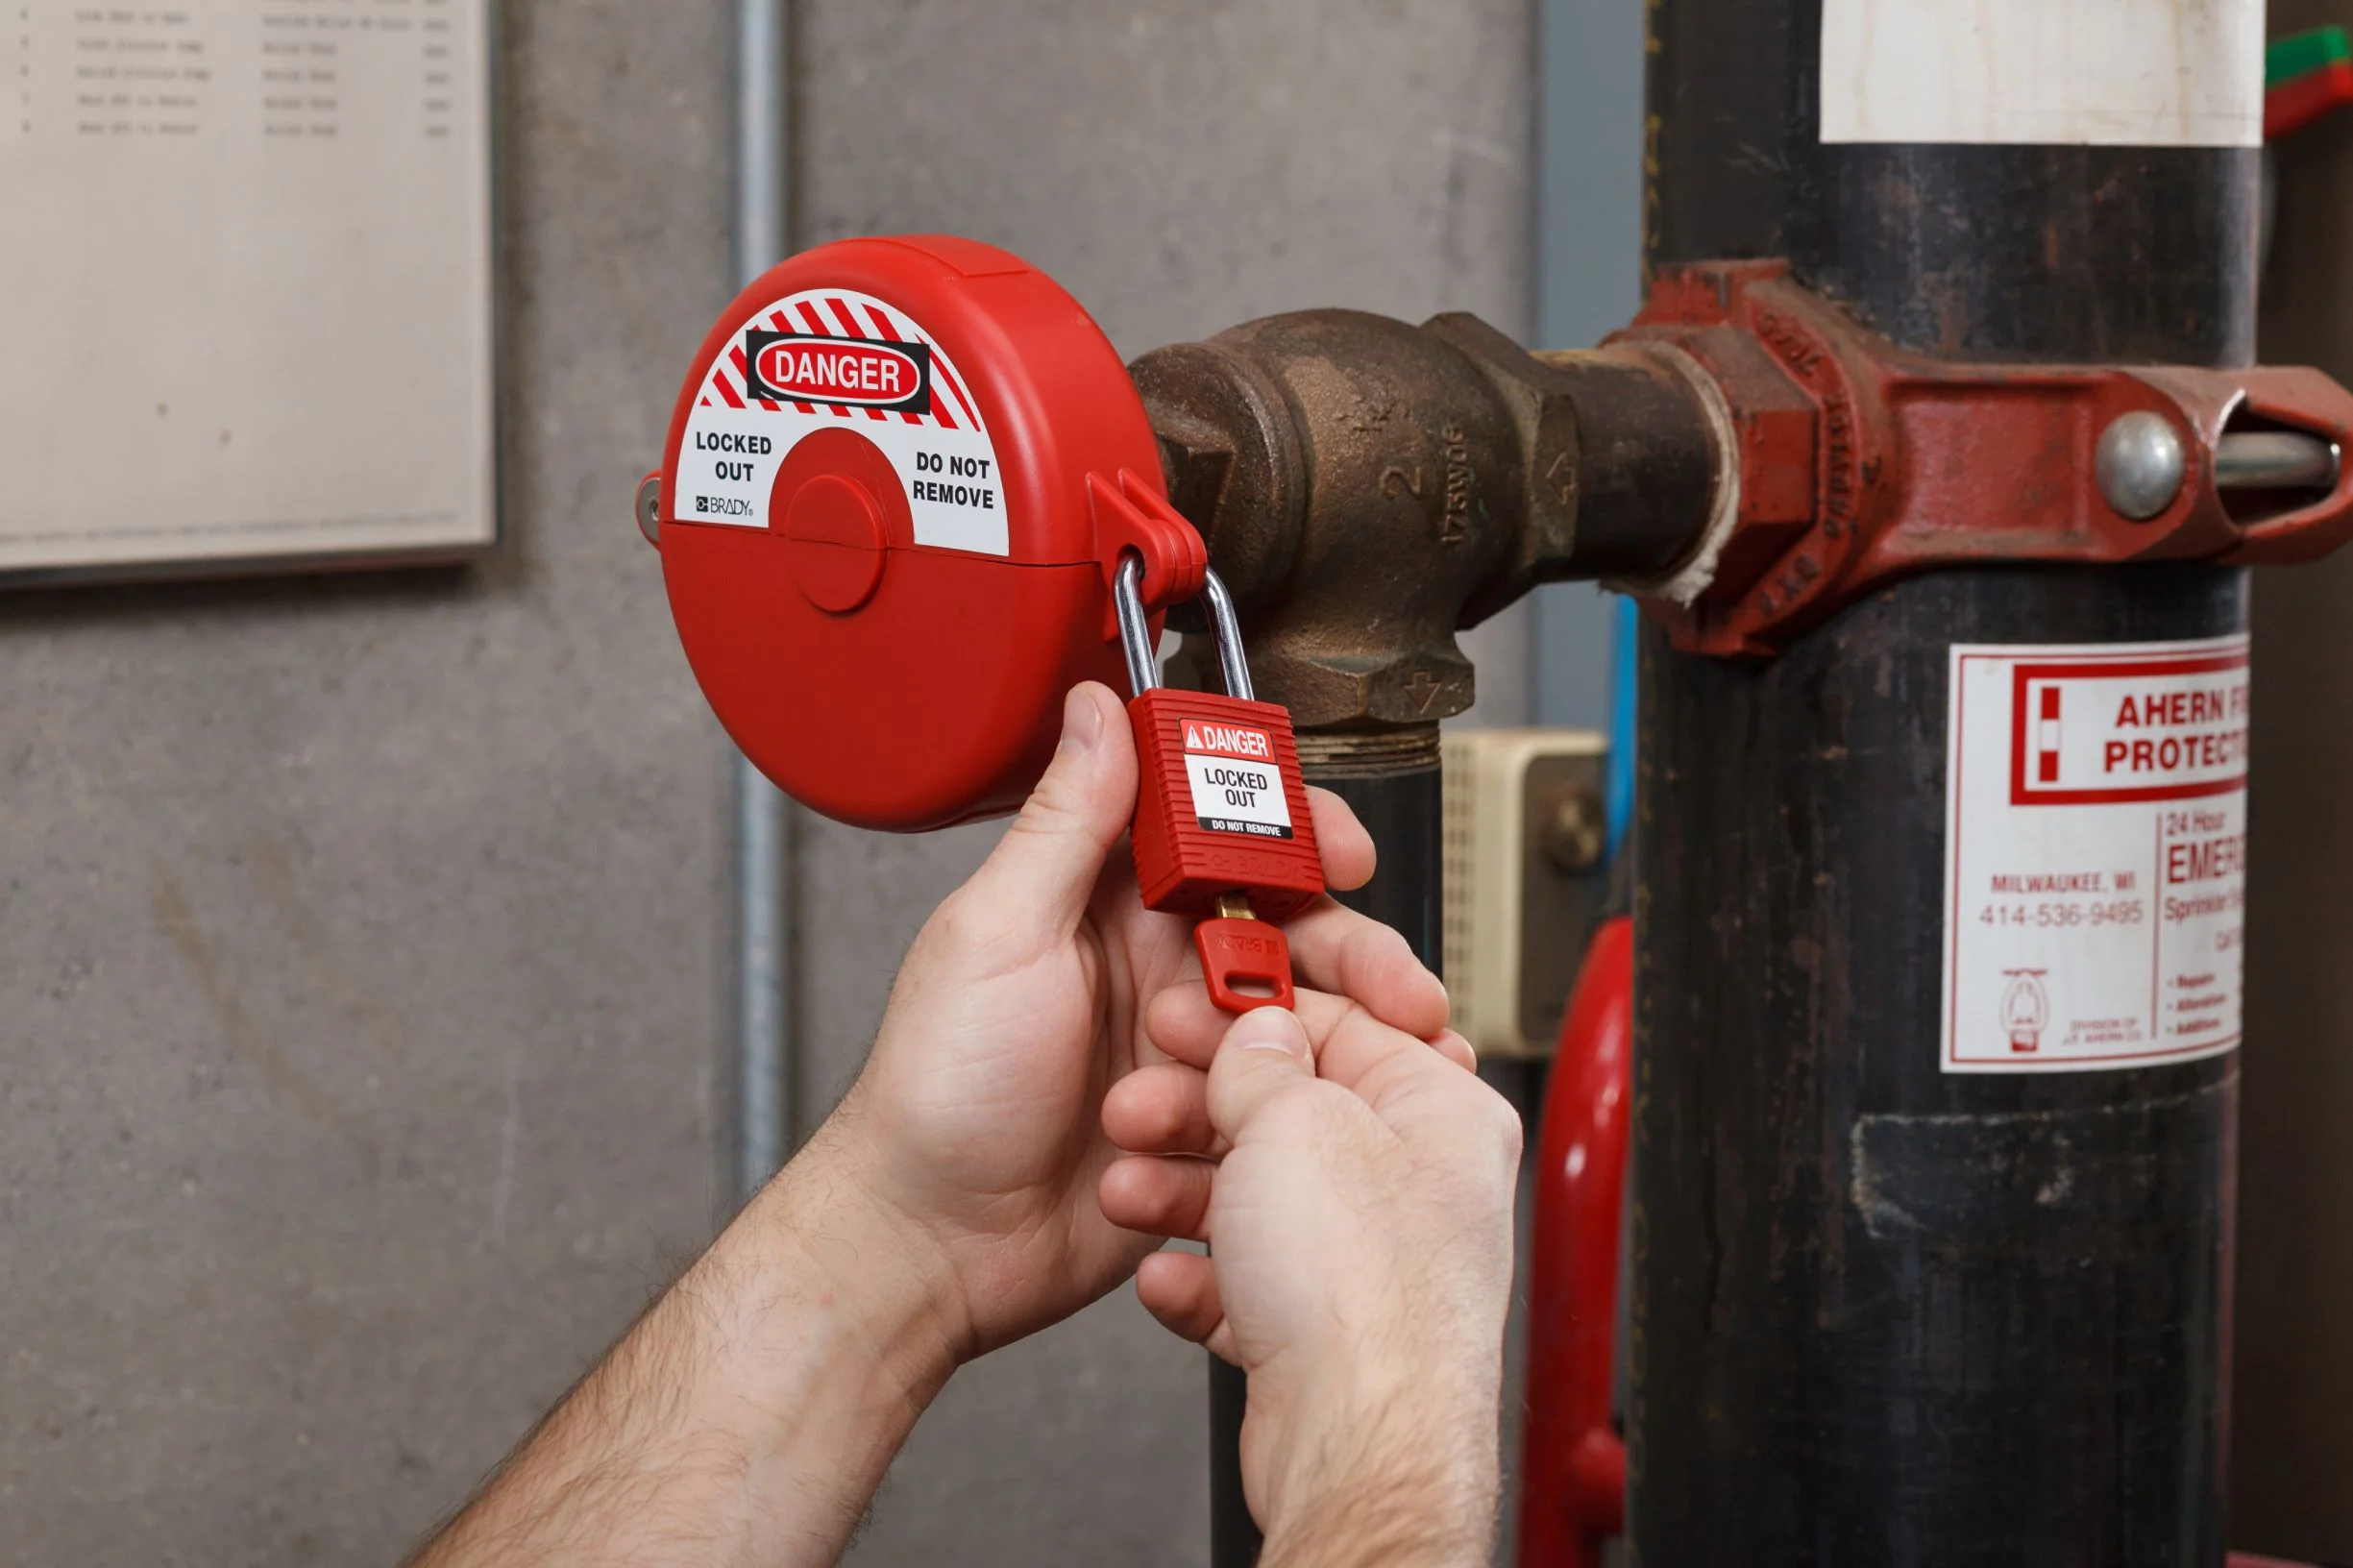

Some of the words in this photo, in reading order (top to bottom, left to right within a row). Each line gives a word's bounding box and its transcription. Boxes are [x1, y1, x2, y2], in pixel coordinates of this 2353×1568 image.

[774, 350, 900, 393] DANGER
[696, 431, 772, 455] LOCKED
[715, 461, 754, 482] OUT
[917, 452, 944, 474] DO
[950, 455, 991, 479] NOT
[913, 480, 994, 510] REMOVE
[2116, 690, 2224, 728] AHERN
[1202, 725, 1269, 758] DANGER
[1204, 768, 1268, 791] LOCKED
[1225, 789, 1256, 808] OUT
[1212, 820, 1225, 830] DO
[1227, 821, 1244, 832] NOT
[1246, 822, 1282, 837] REMOVE
[2166, 811, 2188, 836] 24
[2114, 870, 2136, 892] WI
[1979, 898, 2145, 928] 414-536-9495
